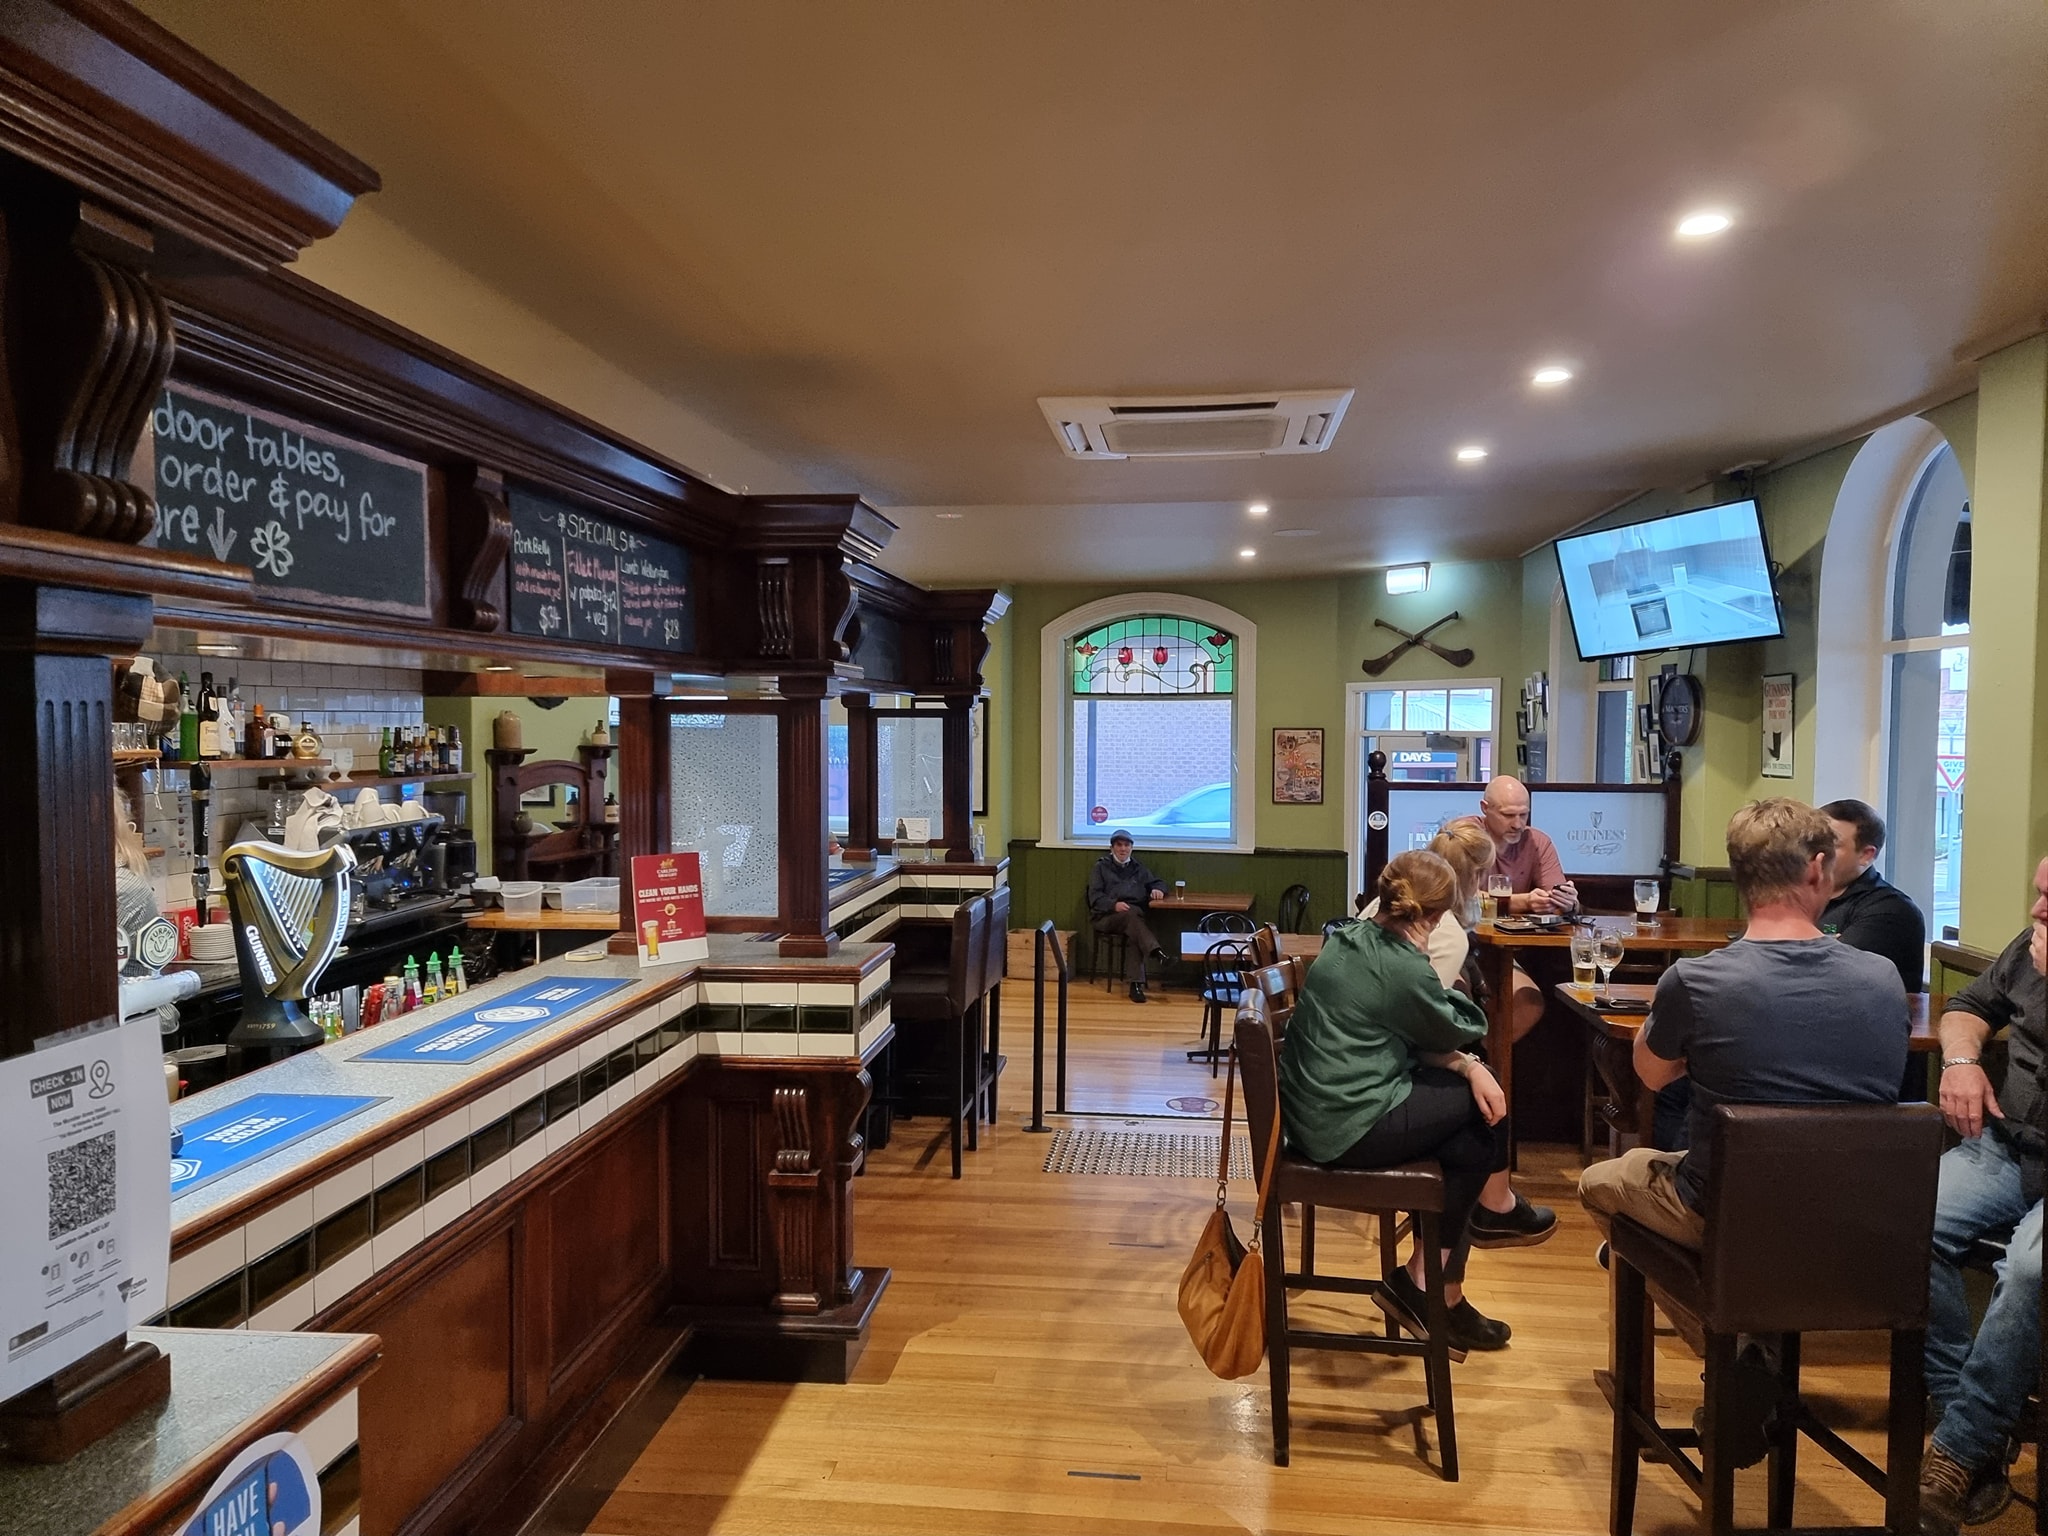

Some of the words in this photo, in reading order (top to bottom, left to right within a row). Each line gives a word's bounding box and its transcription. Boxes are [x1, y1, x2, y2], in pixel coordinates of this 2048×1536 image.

[153, 391, 234, 453] door
[245, 415, 345, 488] tables,
[160, 455, 256, 503] order
[268, 472, 290, 519] &
[296, 488, 351, 544] pay
[359, 492, 396, 541] for
[566, 514, 628, 552] SPECIALS
[1400, 751, 1432, 762] DAYS
[1943, 760, 1965, 768] GIVE
[1566, 829, 1627, 841] GUINNESS
[638, 888, 658, 898] CLEAN
[660, 886, 676, 896] YOUR
[677, 884, 698, 894] HANDS
[150, 928, 175, 942] FURPHY
[245, 925, 277, 985] GUINNESS
[32, 1068, 84, 1095] CHECK-IN
[50, 1093, 71, 1110] NOW
[203, 1124, 251, 1142] BORN
[241, 1117, 267, 1126] IN
[220, 1116, 288, 1143] GEELONG
[214, 1480, 259, 1536] HAVE
